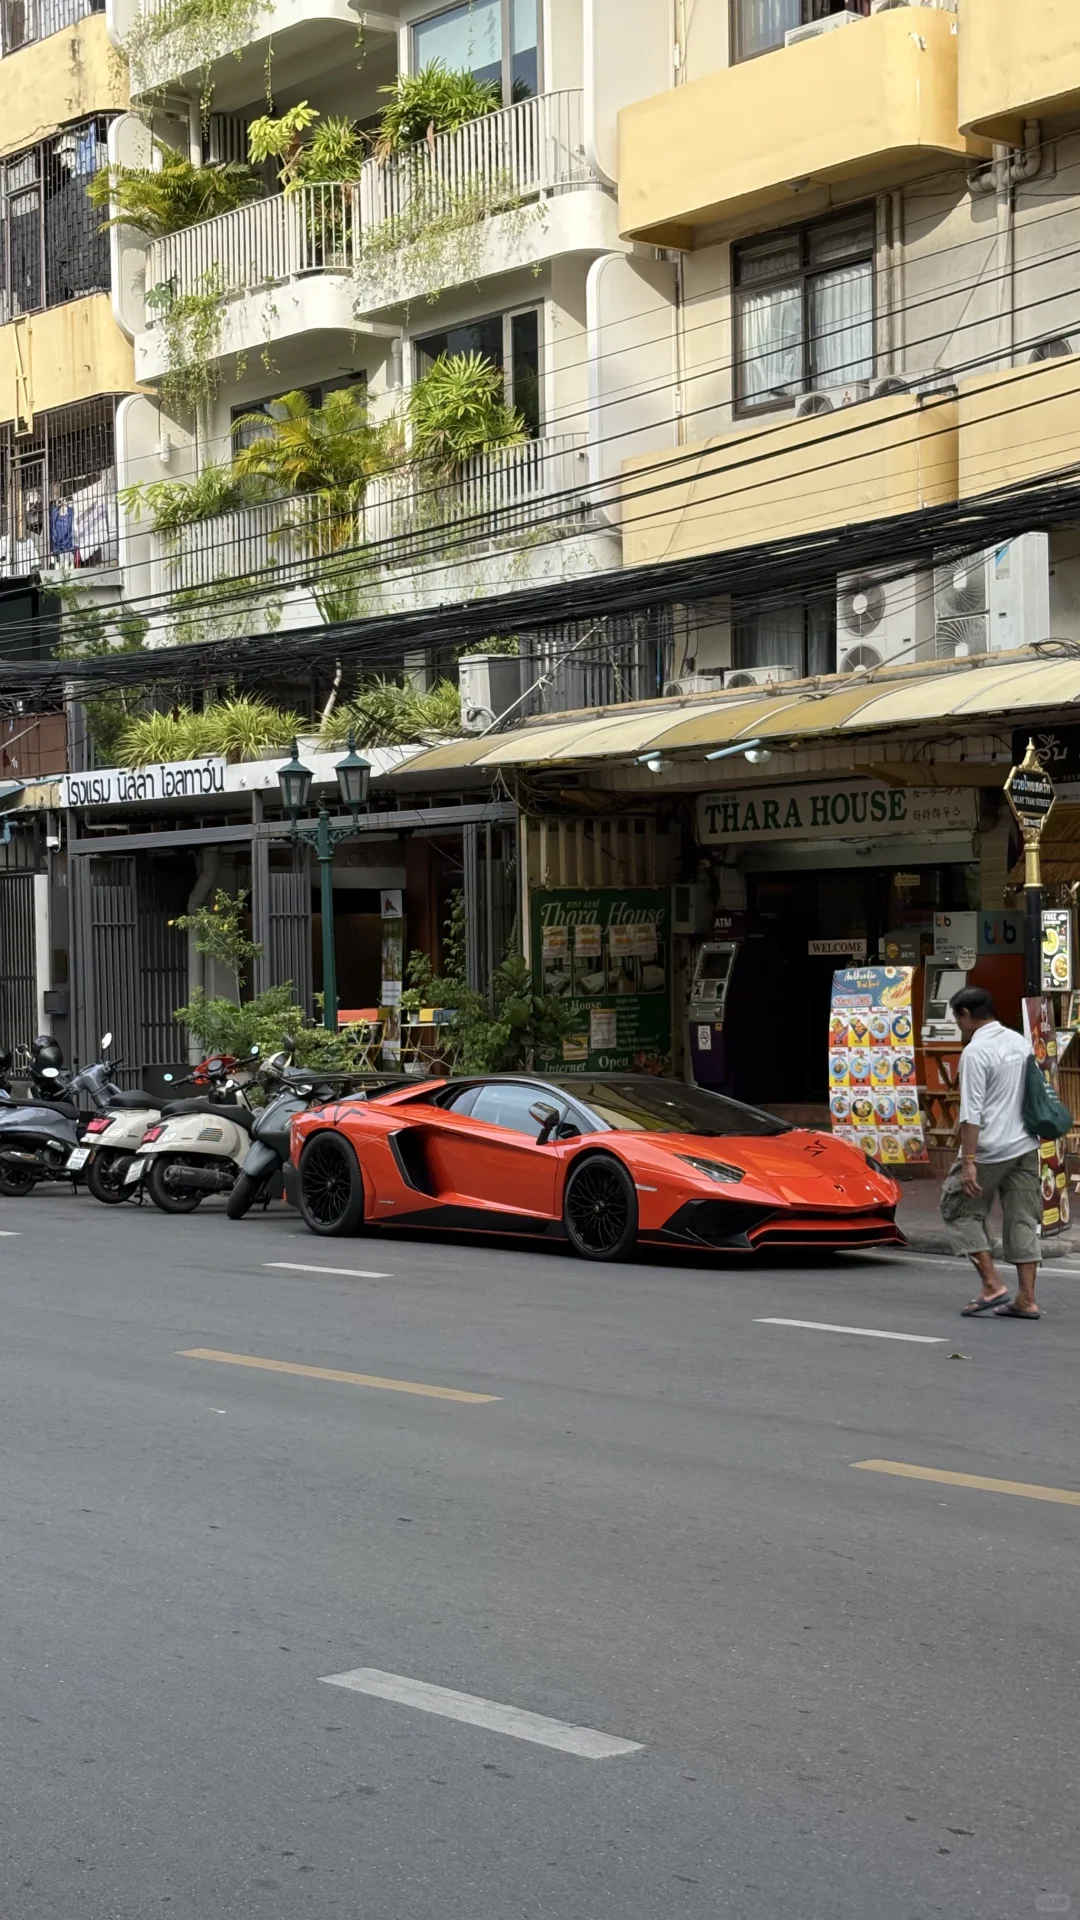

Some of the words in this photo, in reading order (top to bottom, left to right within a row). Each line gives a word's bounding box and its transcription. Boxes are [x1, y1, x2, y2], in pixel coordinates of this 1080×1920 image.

[66, 776, 111, 806] โรงแรม
[704, 797, 803, 834] THARA
[810, 789, 908, 827] HOUSE
[913, 806, 961, 821] 타라하우스
[540, 900, 599, 926] Thara
[601, 901, 666, 935] House
[713, 917, 732, 928] ATM
[812, 941, 864, 953] WELCOME
[961, 948, 975, 956] Get
[900, 950, 916, 959] atm
[571, 999, 602, 1010] House
[543, 1061, 587, 1074] Internet
[598, 1055, 629, 1070] Open
